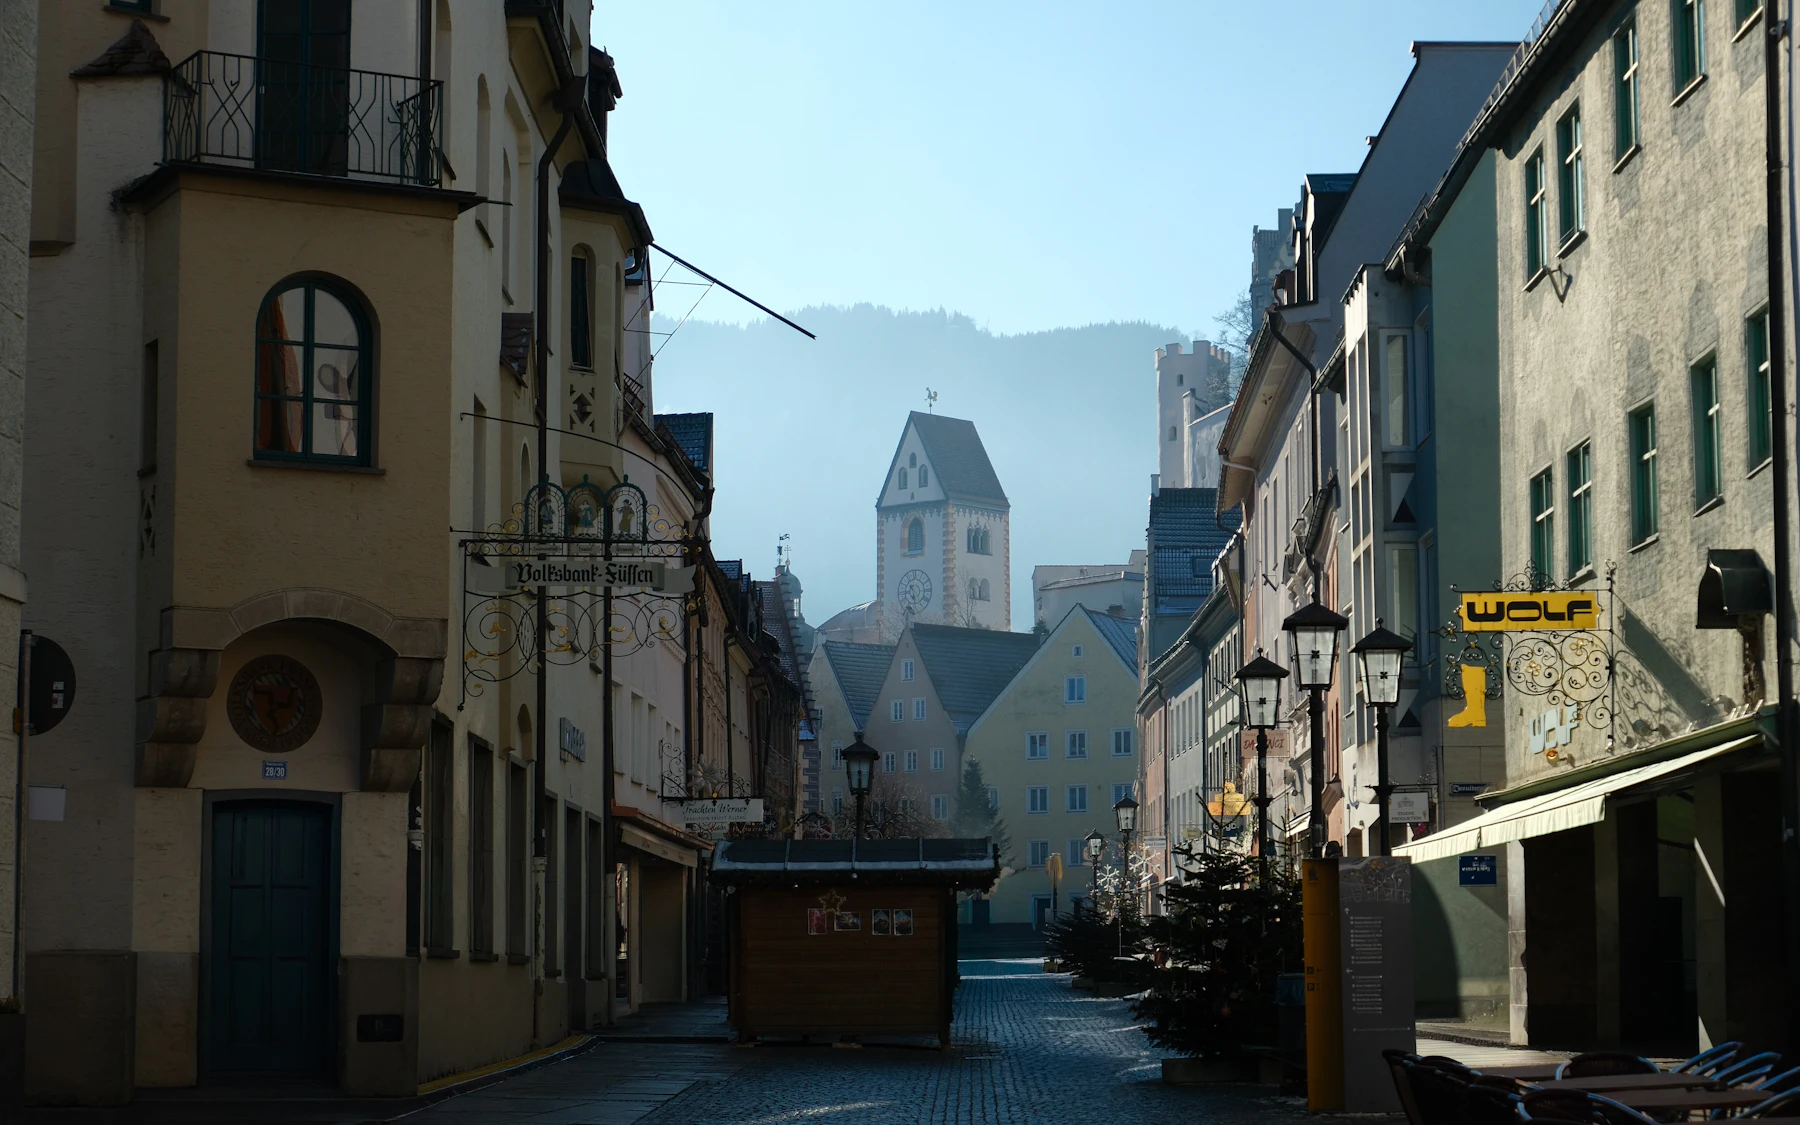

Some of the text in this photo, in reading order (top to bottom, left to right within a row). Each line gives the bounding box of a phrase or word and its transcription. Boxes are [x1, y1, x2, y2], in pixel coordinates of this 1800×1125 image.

[1466, 600, 1592, 622] WOLF
[1529, 701, 1579, 754] WOLF
[265, 766, 285, 778] 28/30
[682, 803, 747, 815] Trachten Werner
